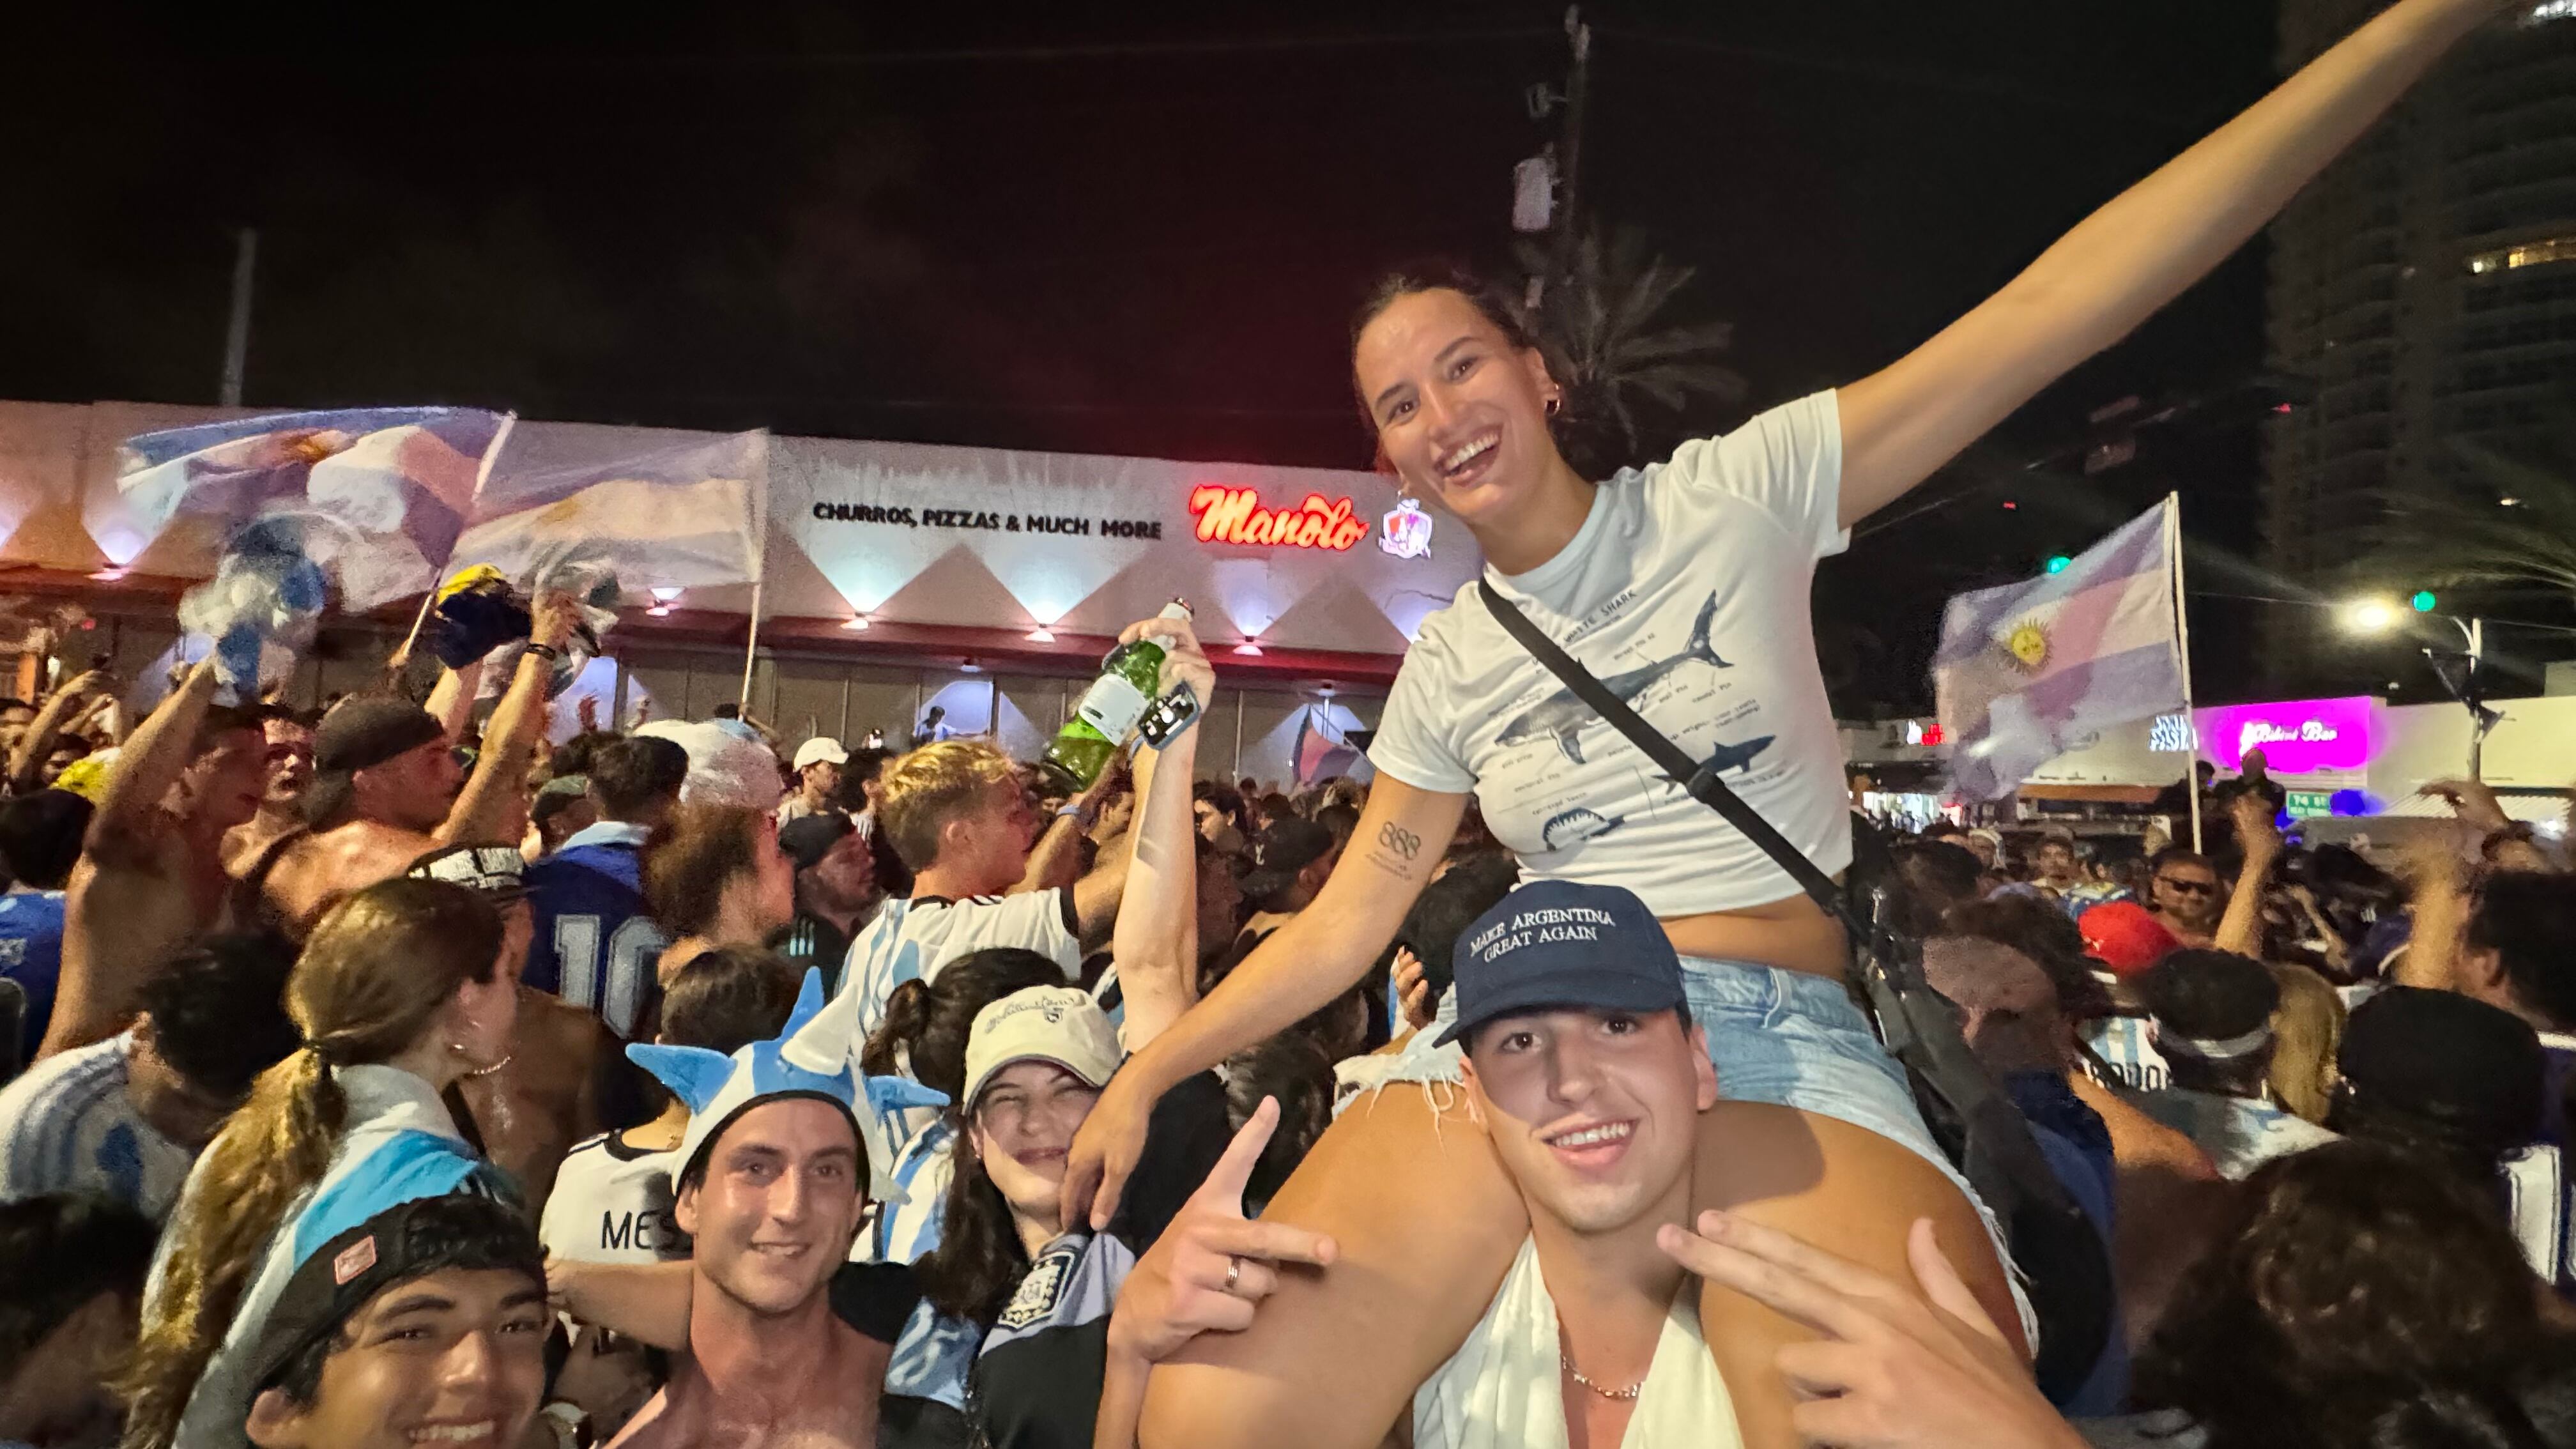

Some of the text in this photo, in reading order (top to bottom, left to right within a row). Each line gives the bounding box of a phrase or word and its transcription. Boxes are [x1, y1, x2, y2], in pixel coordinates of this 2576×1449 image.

[813, 502, 1162, 540] CHURROS, PIZZAS & MUCH MORE
[1189, 484, 1369, 551] Manolo
[1600, 590, 1637, 617] SHARK
[1470, 908, 1616, 958] MAKE ARGENTINA
[1483, 926, 1598, 963] GREAT AGAIN
